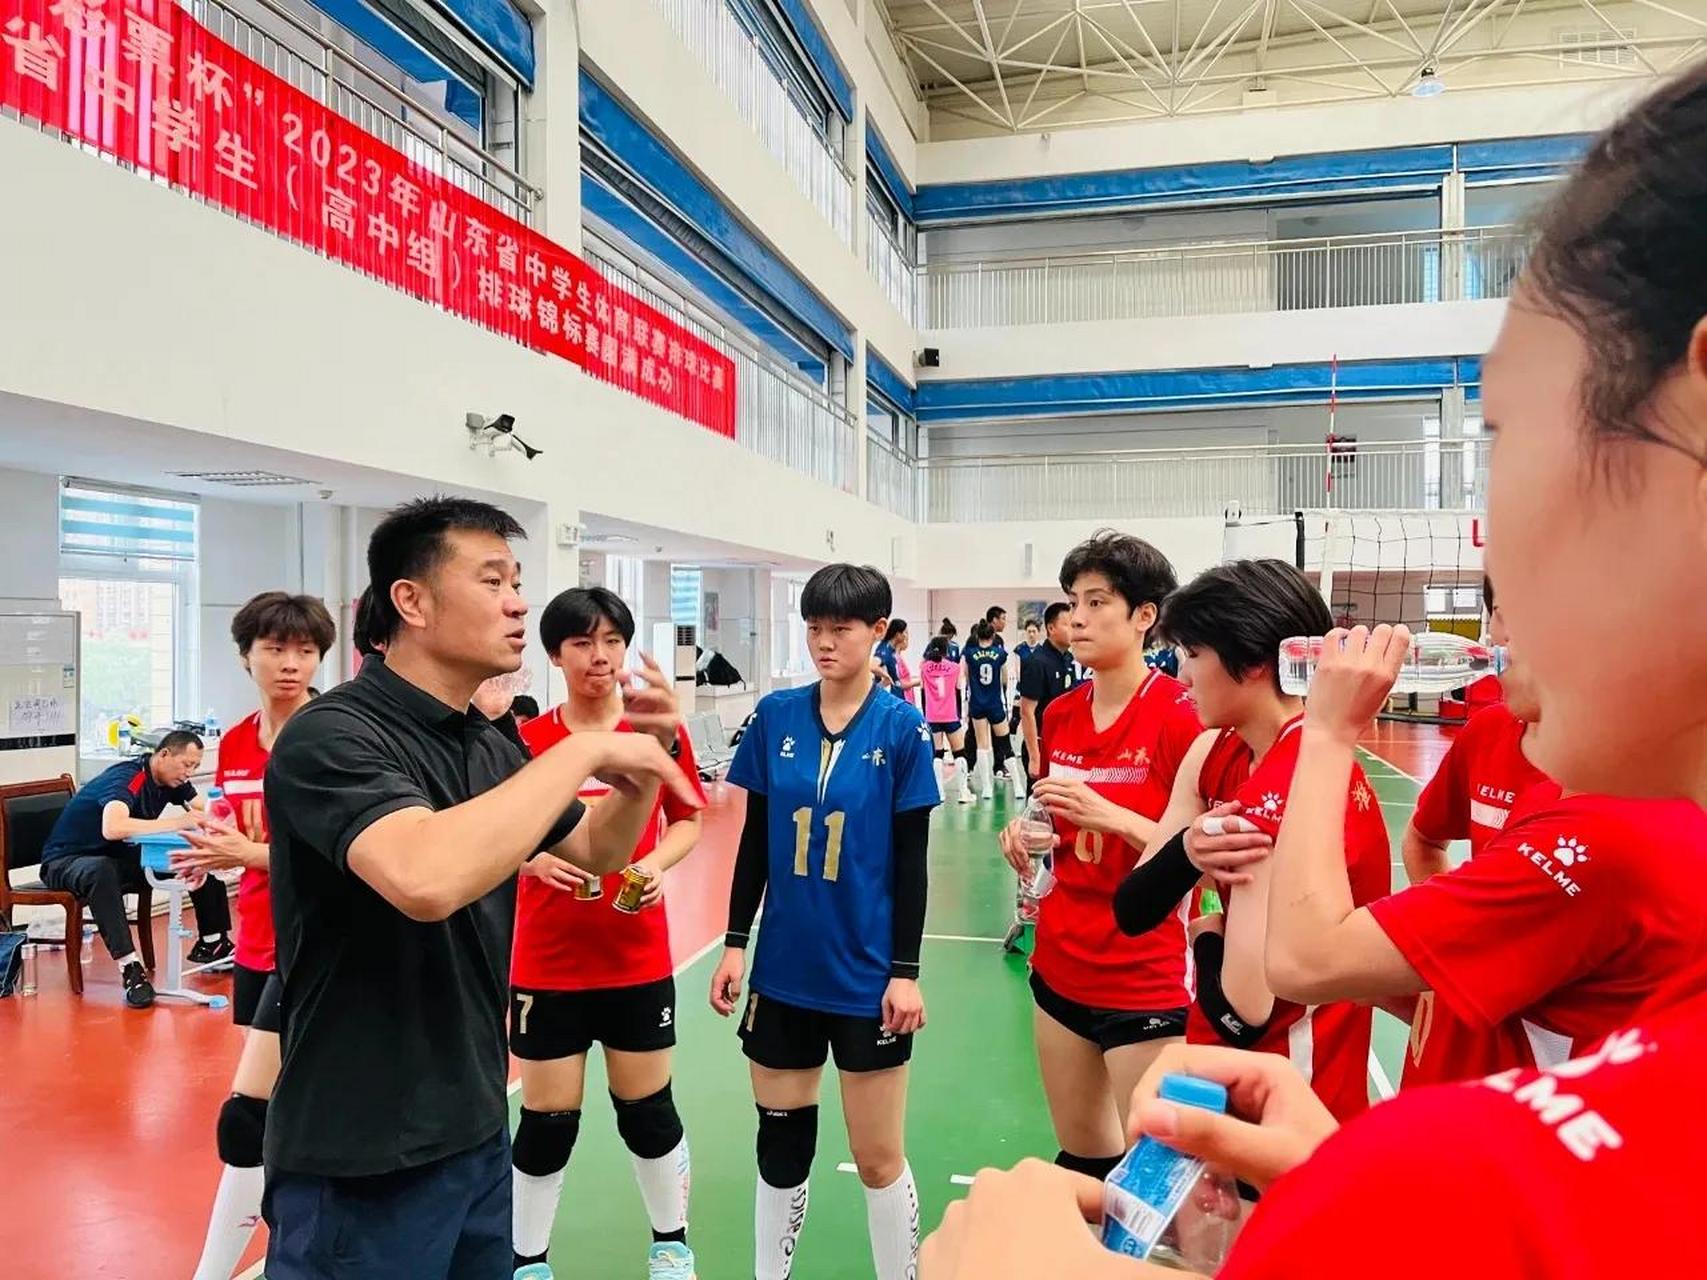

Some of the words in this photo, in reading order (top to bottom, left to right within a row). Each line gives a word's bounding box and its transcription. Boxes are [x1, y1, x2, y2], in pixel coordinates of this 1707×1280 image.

[980, 663, 993, 686] 9
[792, 806, 845, 882] 11
[1517, 842, 1582, 897] KELME
[516, 993, 533, 1034] 7
